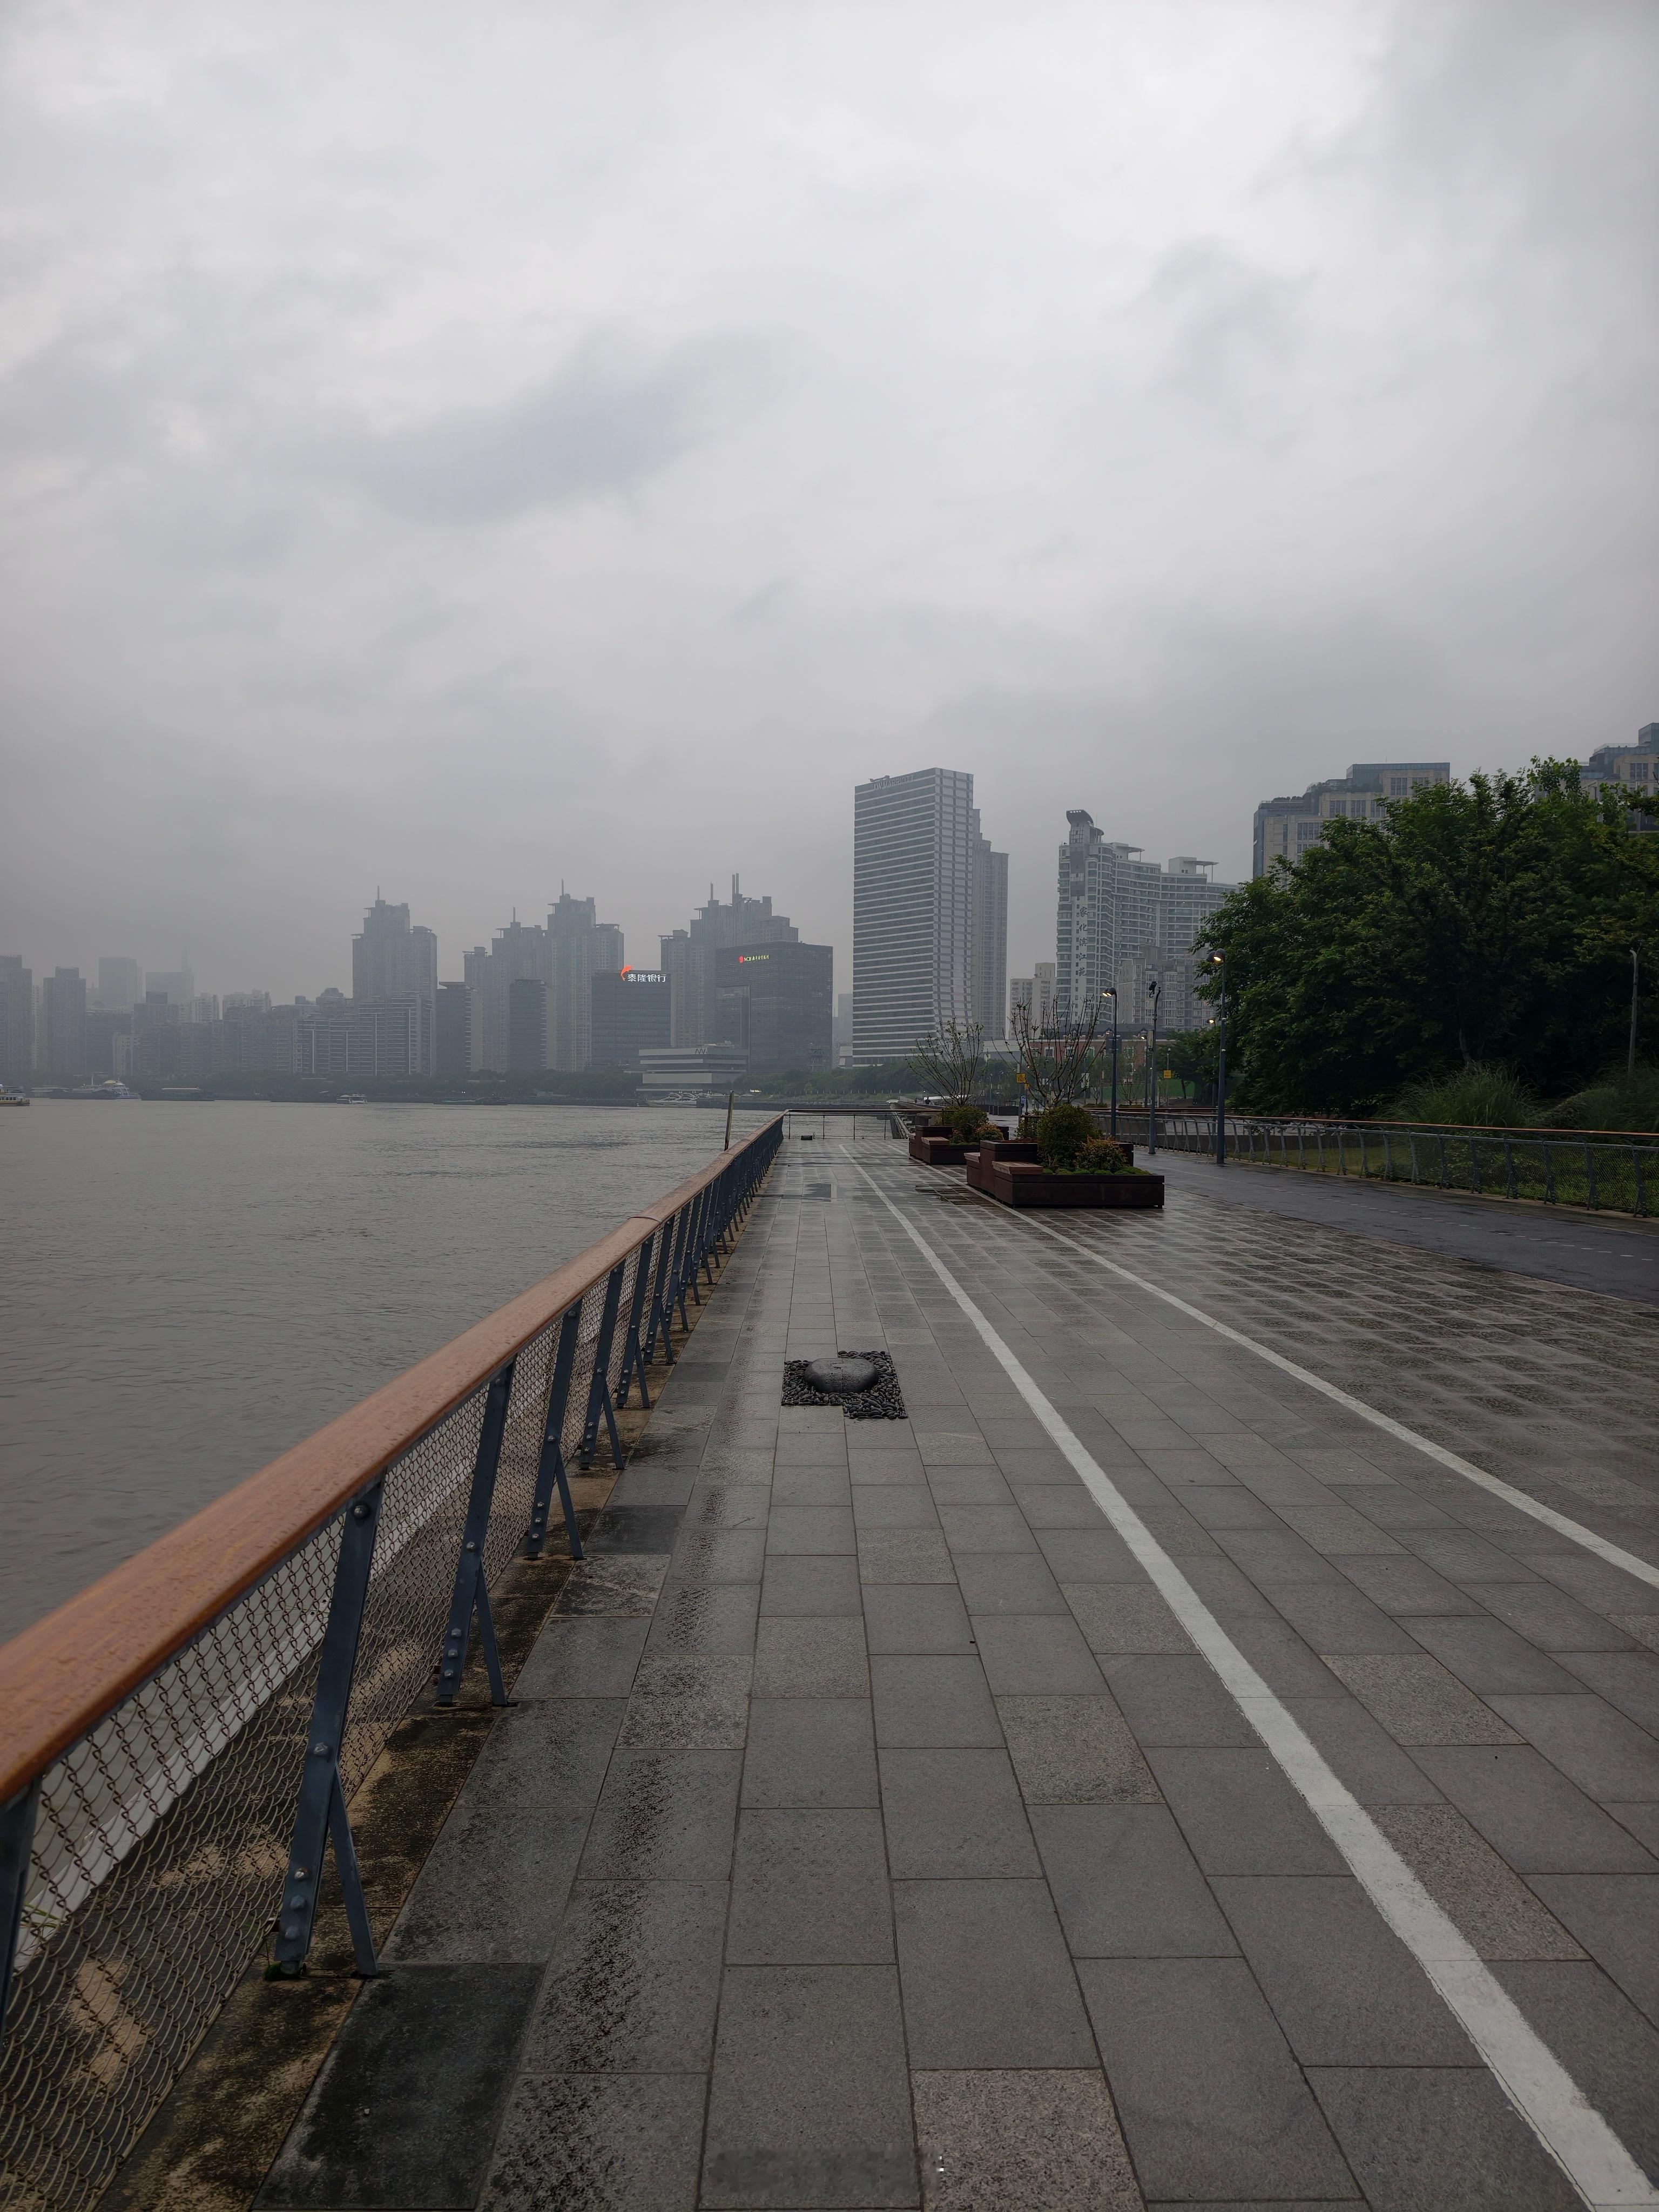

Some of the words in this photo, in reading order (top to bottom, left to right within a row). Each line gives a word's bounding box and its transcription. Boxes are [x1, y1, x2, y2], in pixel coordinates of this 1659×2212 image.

[882, 774, 914, 788] MARRIOTT
[1079, 906, 1089, 976] 家化滨江苑
[628, 974, 667, 982] 泰隆银行
